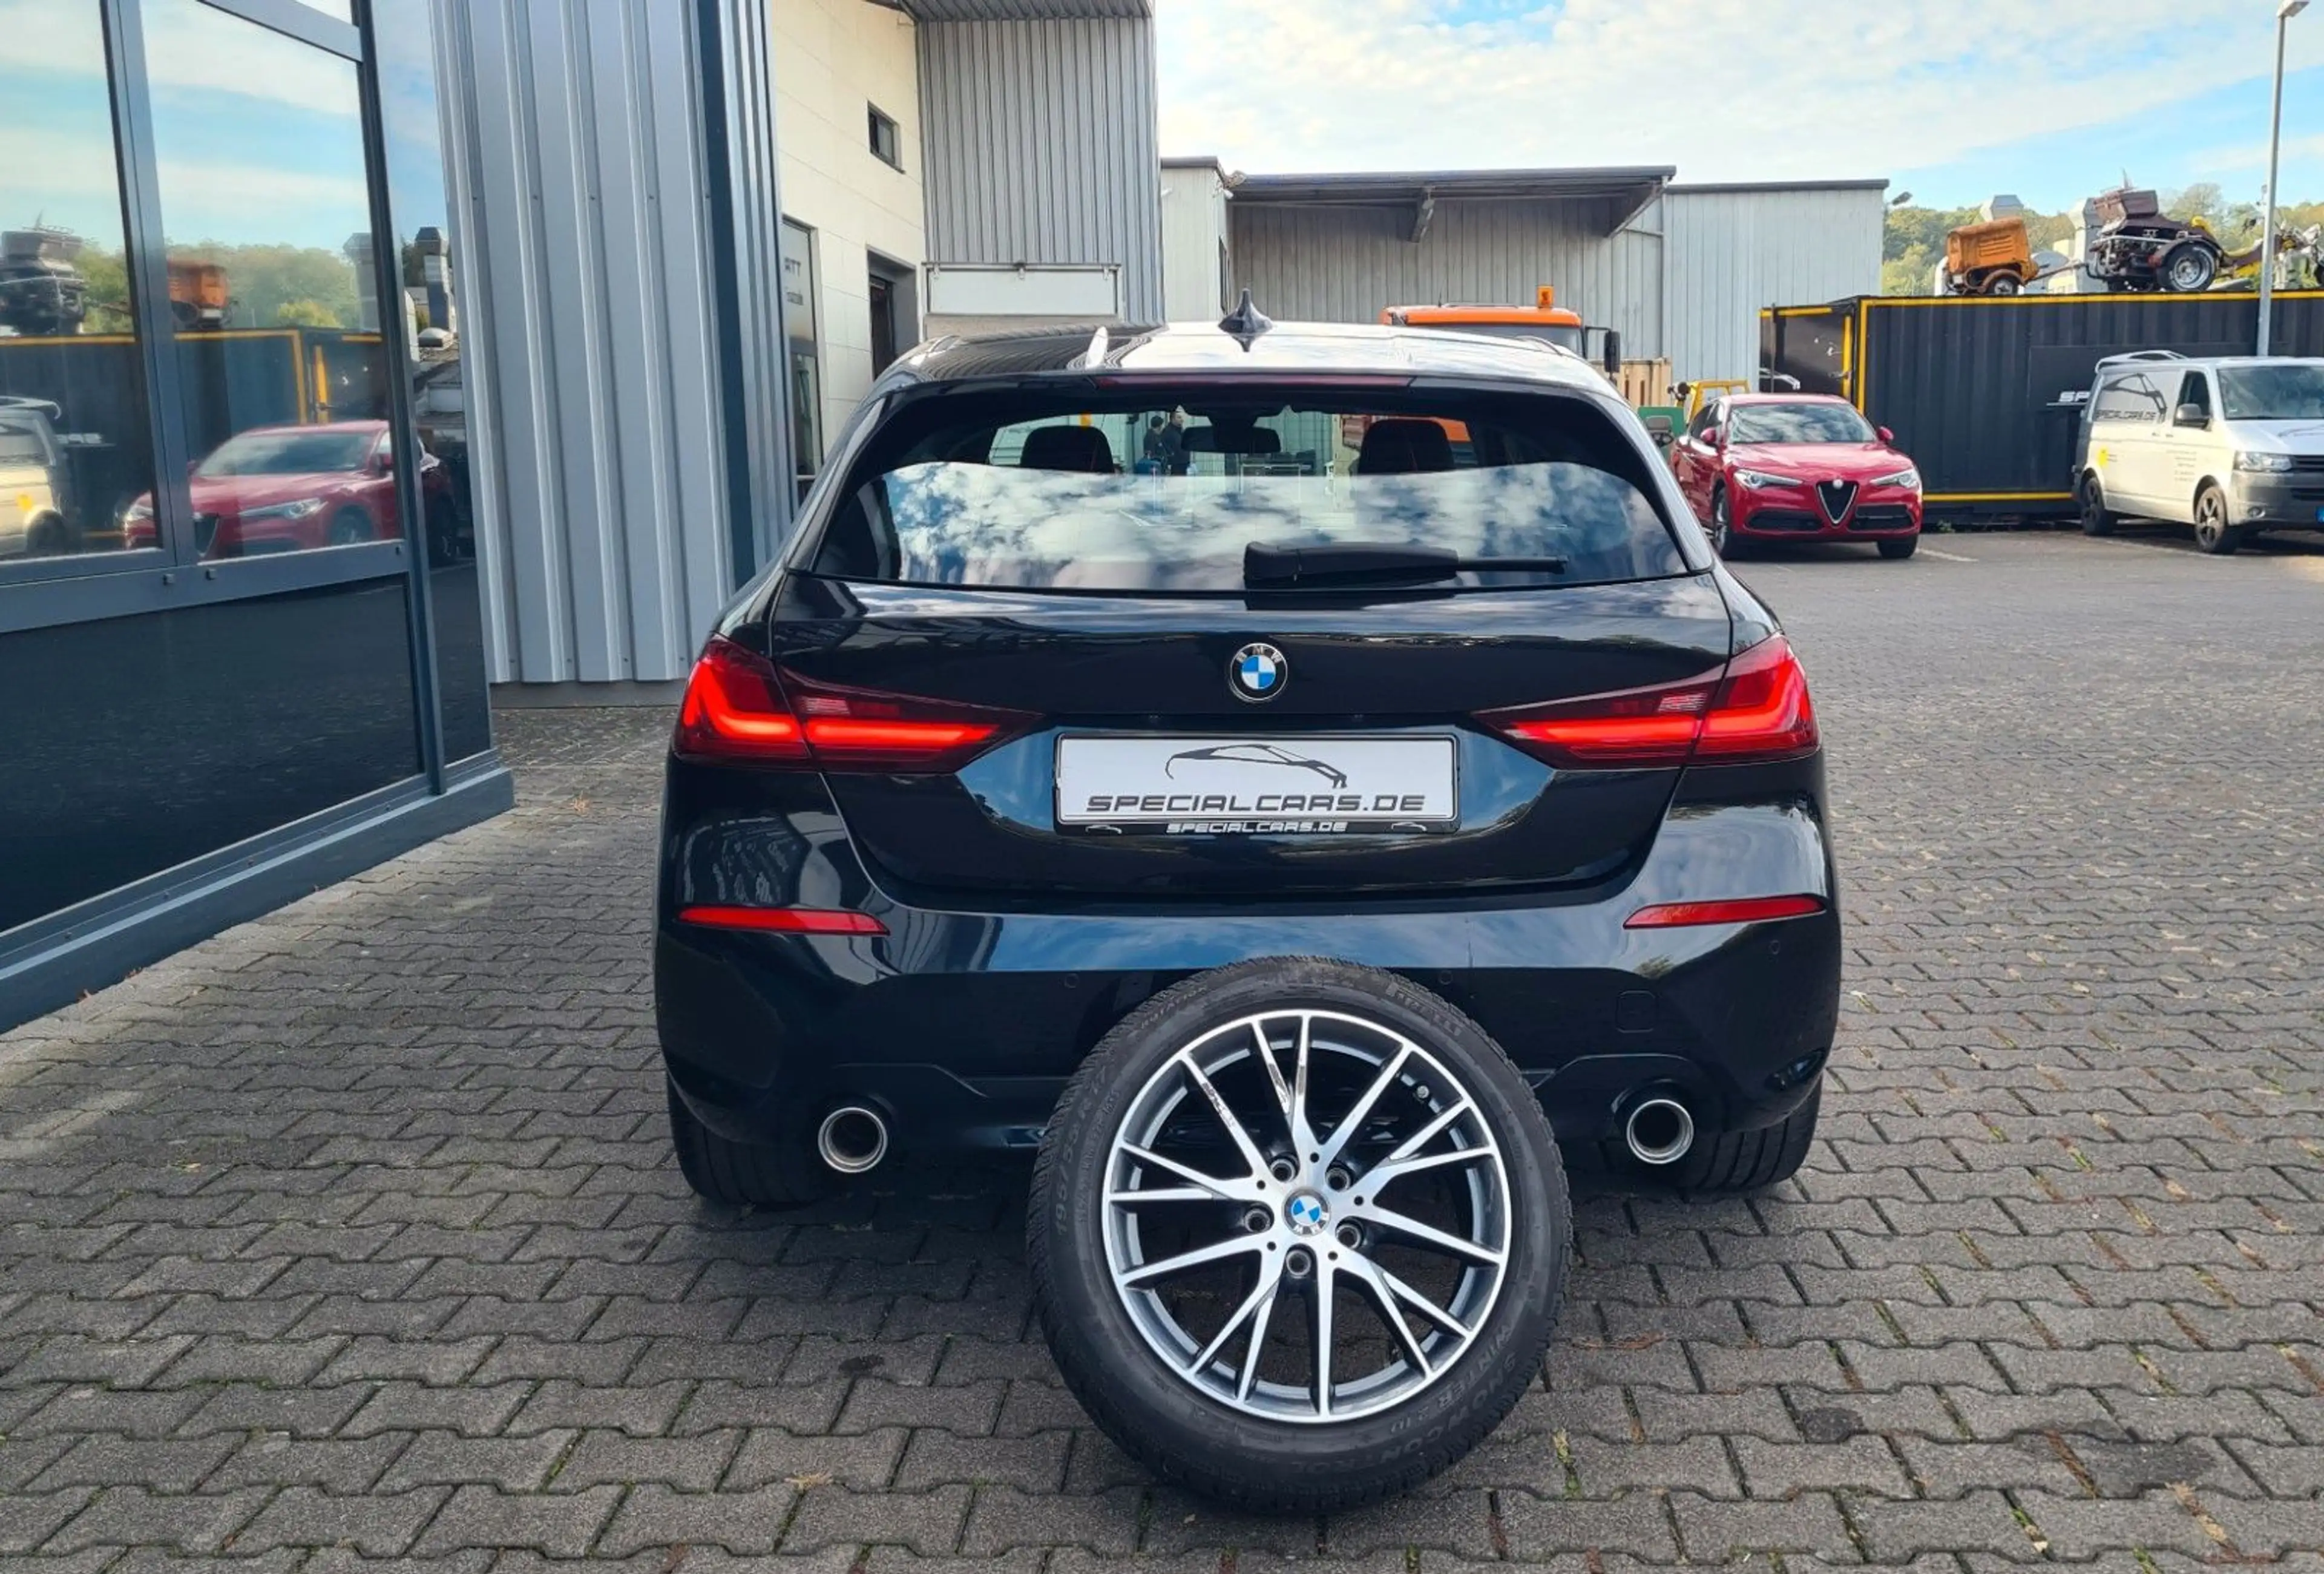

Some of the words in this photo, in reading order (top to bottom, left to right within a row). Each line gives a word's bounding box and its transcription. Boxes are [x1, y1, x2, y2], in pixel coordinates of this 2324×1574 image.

[1236, 645, 1282, 664] BMW
[1086, 795, 1425, 812] SPECIALCARS.DE
[1166, 822, 1348, 833] SPECIALCARS.DE
[1385, 981, 1462, 1037] PIRELLI
